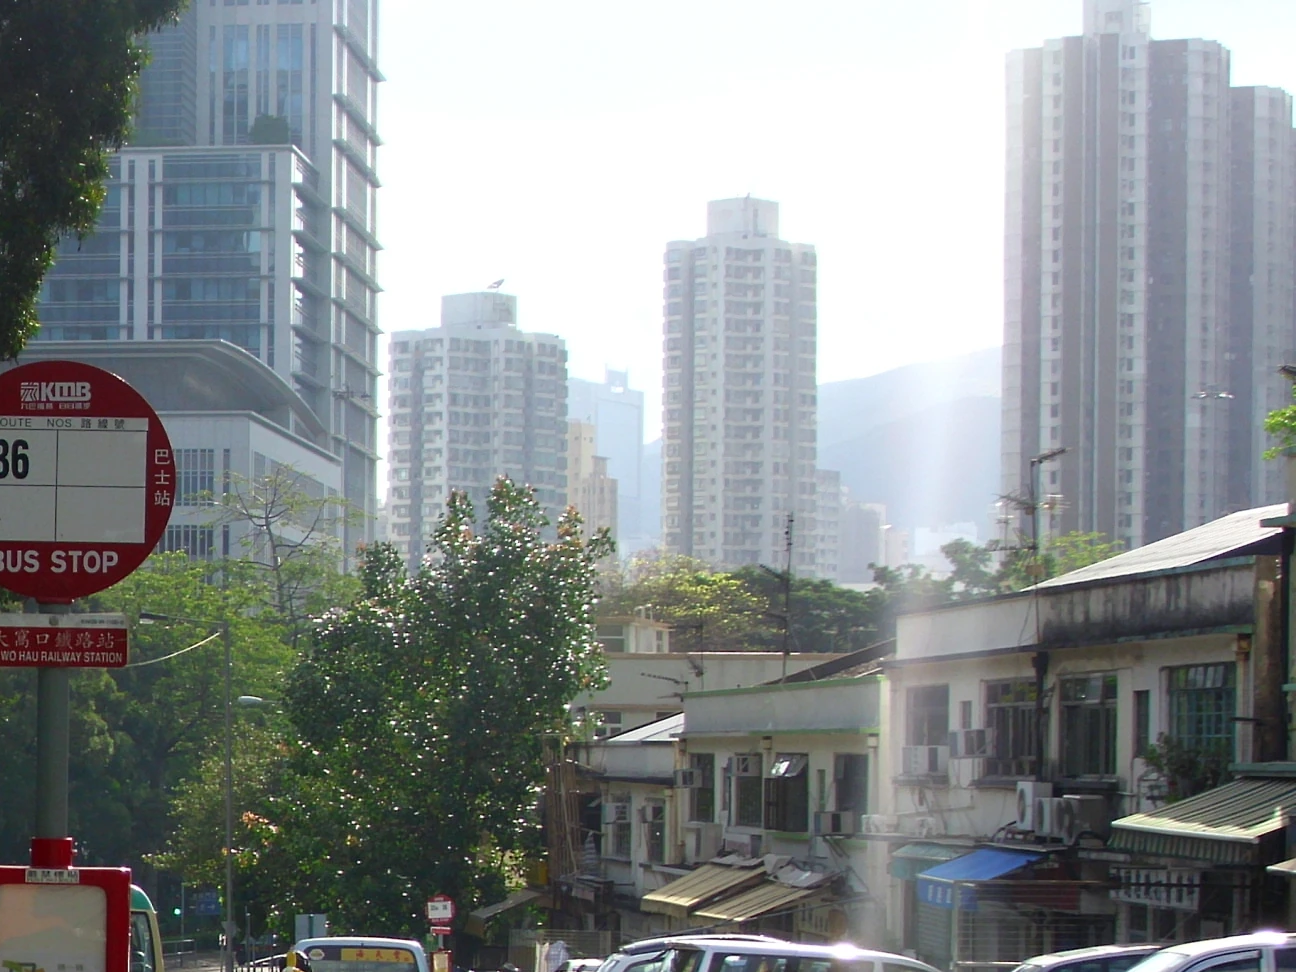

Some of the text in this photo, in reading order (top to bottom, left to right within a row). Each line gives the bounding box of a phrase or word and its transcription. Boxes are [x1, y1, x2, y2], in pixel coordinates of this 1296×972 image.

[40, 381, 92, 402] KMB
[46, 417, 72, 428] NOS
[153, 448, 171, 507] 巴士站
[50, 550, 119, 574] STOP
[1, 650, 17, 662] WO
[19, 651, 39, 662] HAU
[41, 651, 82, 663] RAILWAY
[83, 651, 123, 663] STATION
